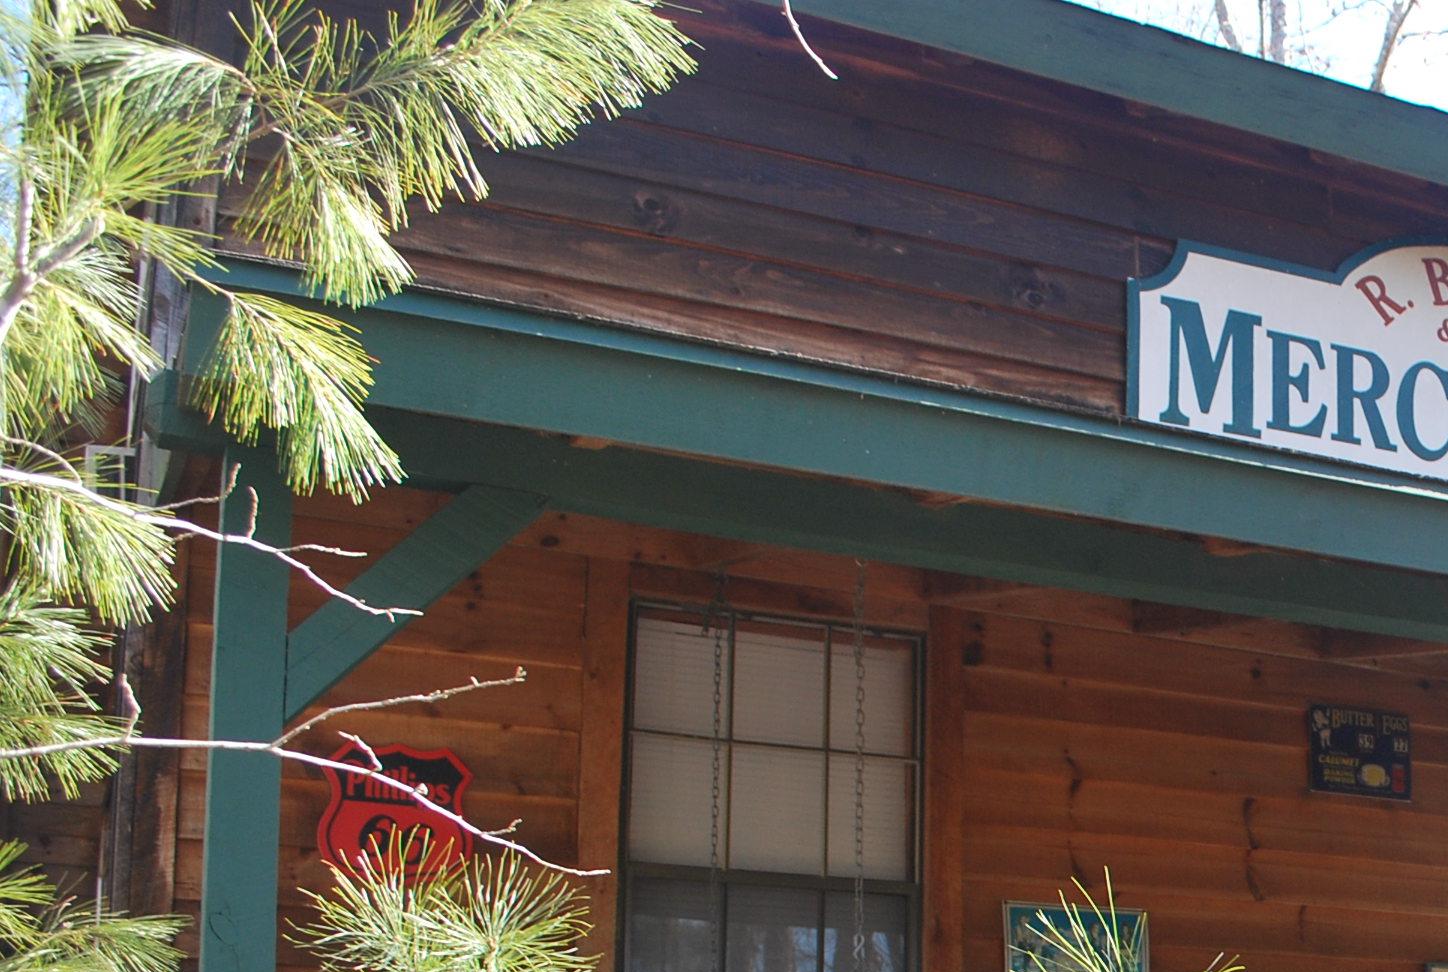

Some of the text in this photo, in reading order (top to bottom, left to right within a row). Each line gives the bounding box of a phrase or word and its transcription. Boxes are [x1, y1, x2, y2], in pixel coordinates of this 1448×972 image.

[1356, 275, 1413, 327] R.
[1331, 708, 1375, 728] BUTTER
[359, 814, 435, 867] 66
